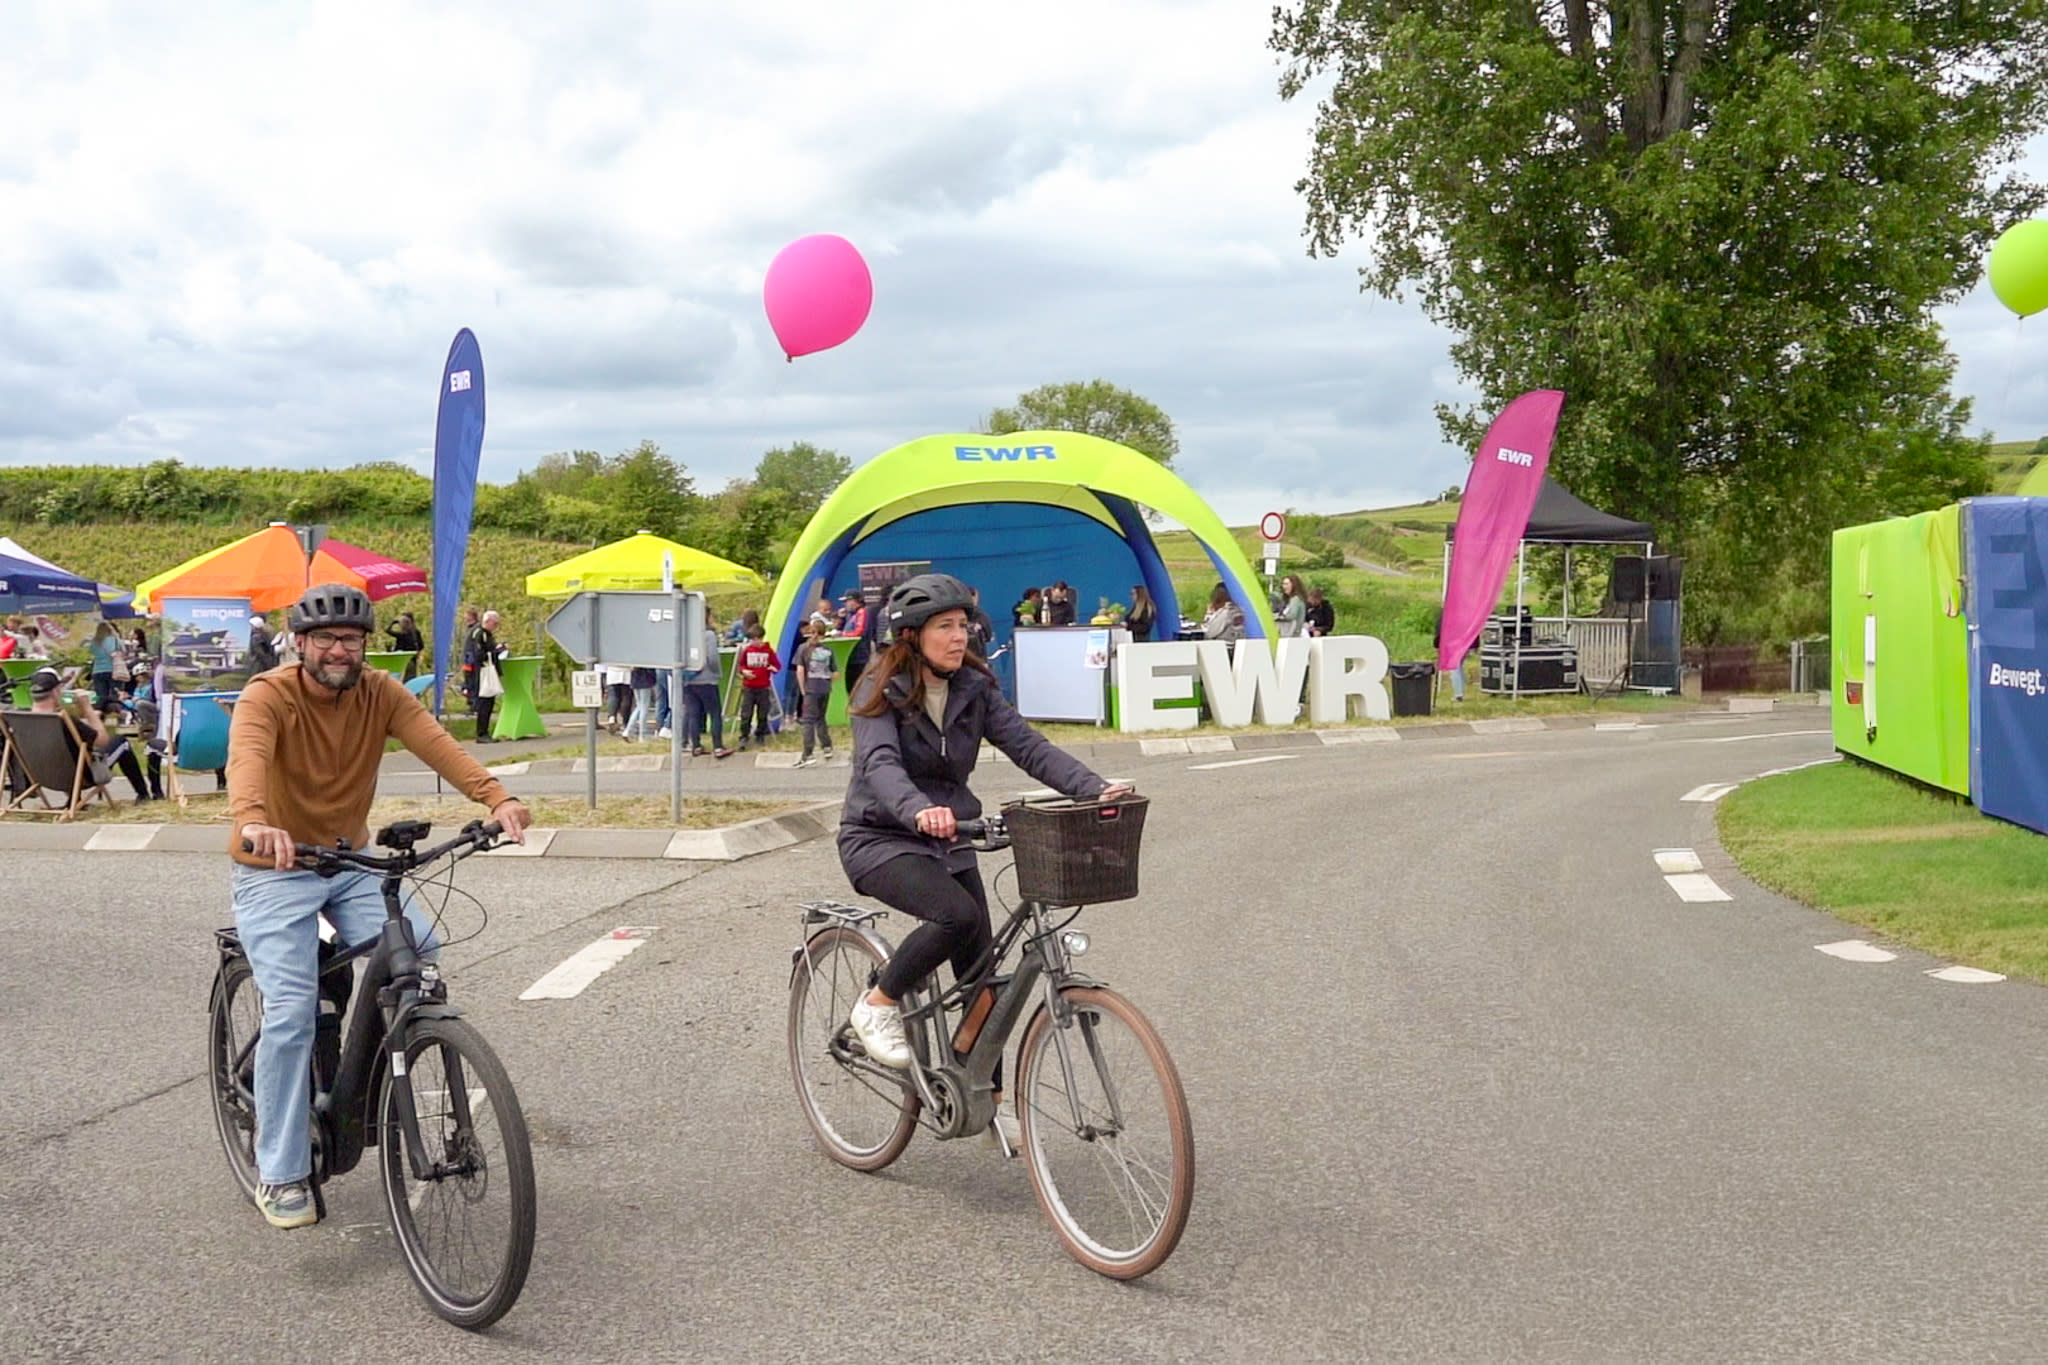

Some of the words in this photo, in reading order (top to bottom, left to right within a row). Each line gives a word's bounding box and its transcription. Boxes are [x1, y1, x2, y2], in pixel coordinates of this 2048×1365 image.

[451, 370, 471, 392] EWR
[955, 445, 1056, 461] EWR
[1497, 448, 1533, 467] EWR
[1117, 635, 1391, 733] EWR
[1989, 662, 2046, 697] Bewegt,
